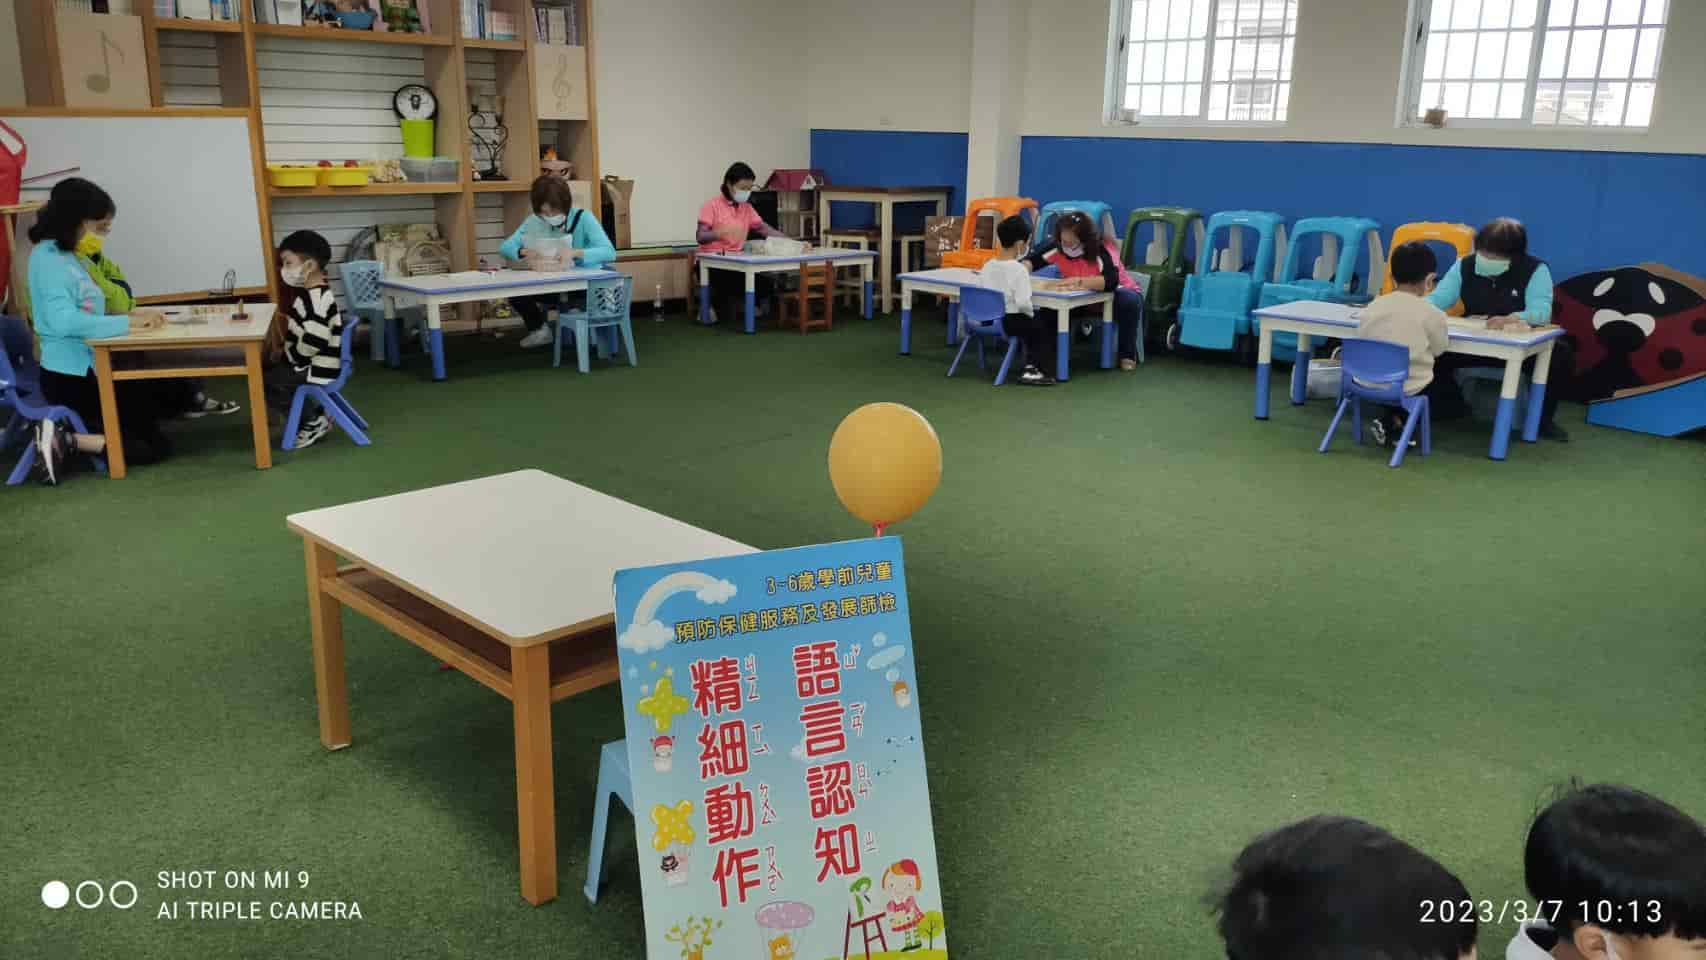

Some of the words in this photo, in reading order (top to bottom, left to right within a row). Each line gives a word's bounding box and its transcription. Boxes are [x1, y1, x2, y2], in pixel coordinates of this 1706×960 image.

[689, 656, 761, 909] 精細動作
[792, 640, 862, 884] 語言認知
